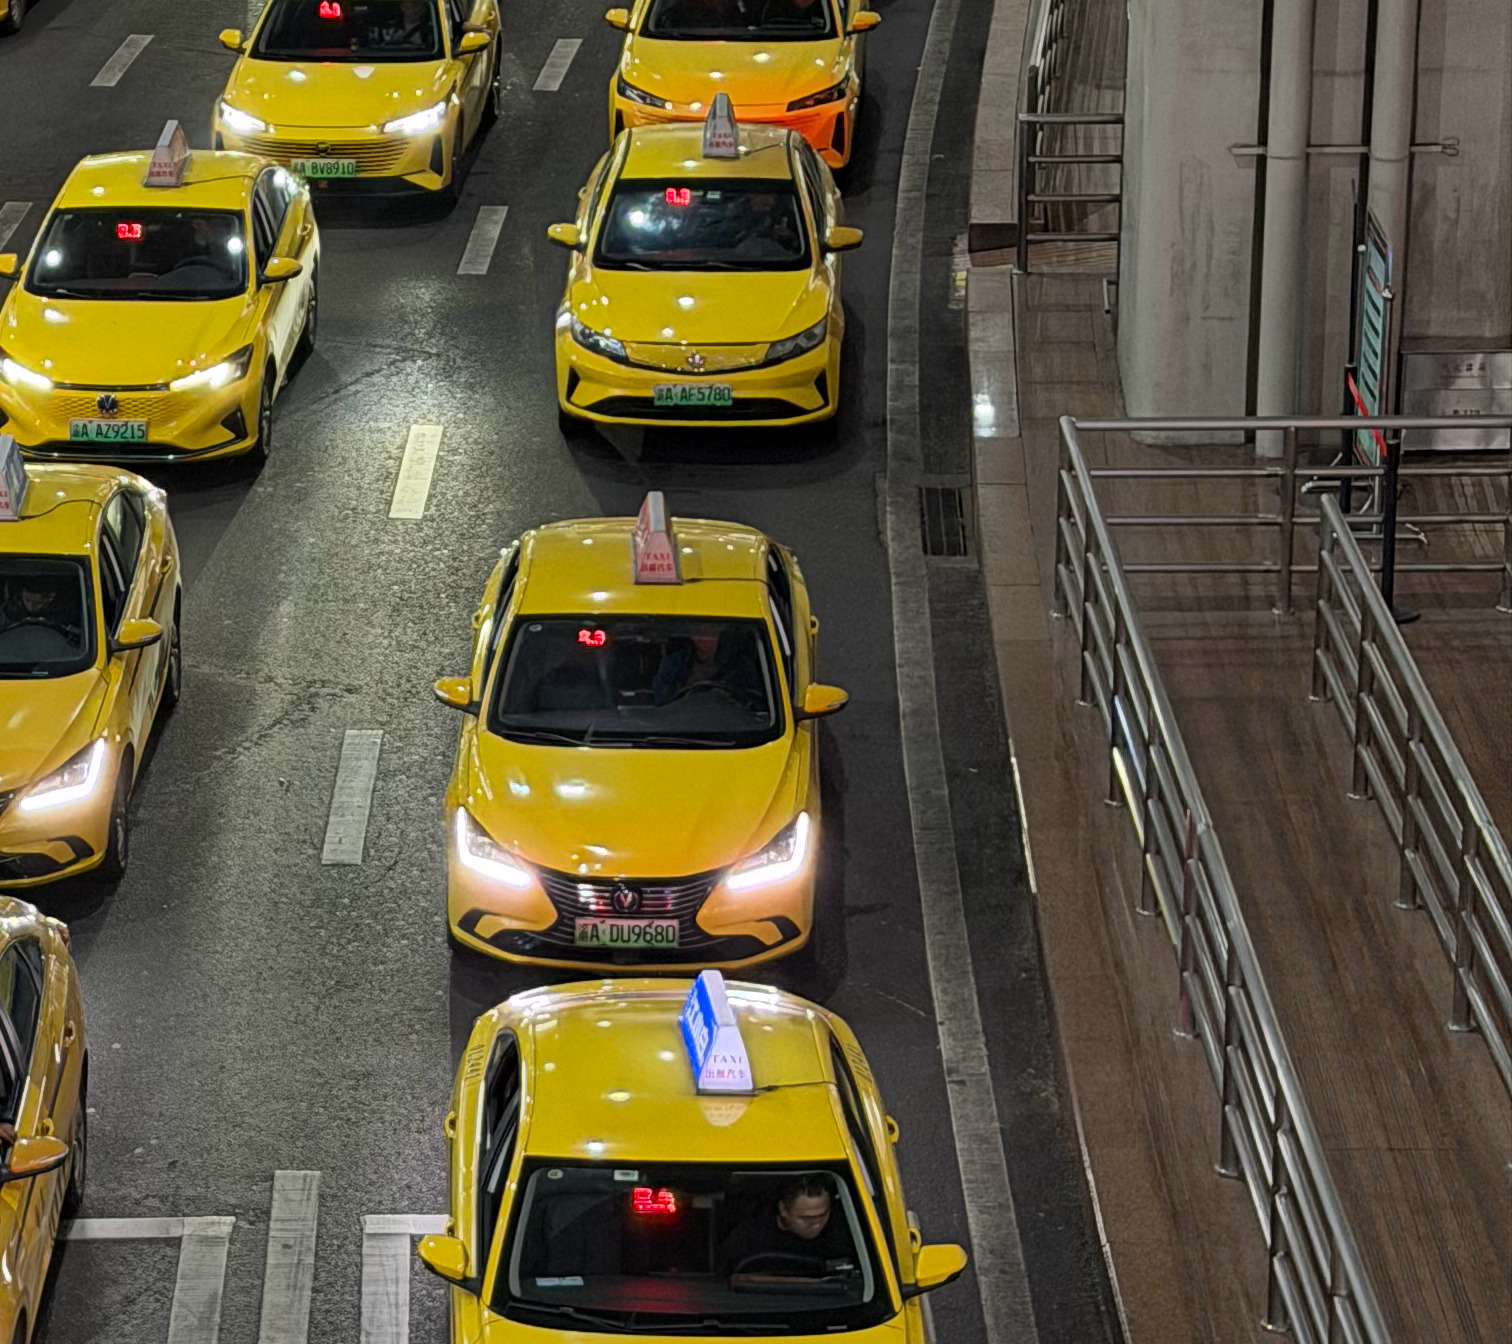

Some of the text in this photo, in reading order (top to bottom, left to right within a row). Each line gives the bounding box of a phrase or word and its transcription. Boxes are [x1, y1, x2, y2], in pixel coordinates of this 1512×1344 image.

[95, 422, 146, 440] AZ9215
[644, 552, 670, 560] TAXI
[609, 923, 677, 944] DU9680
[712, 1054, 743, 1064] TAXI
[704, 1069, 746, 1080] 出租汽车
